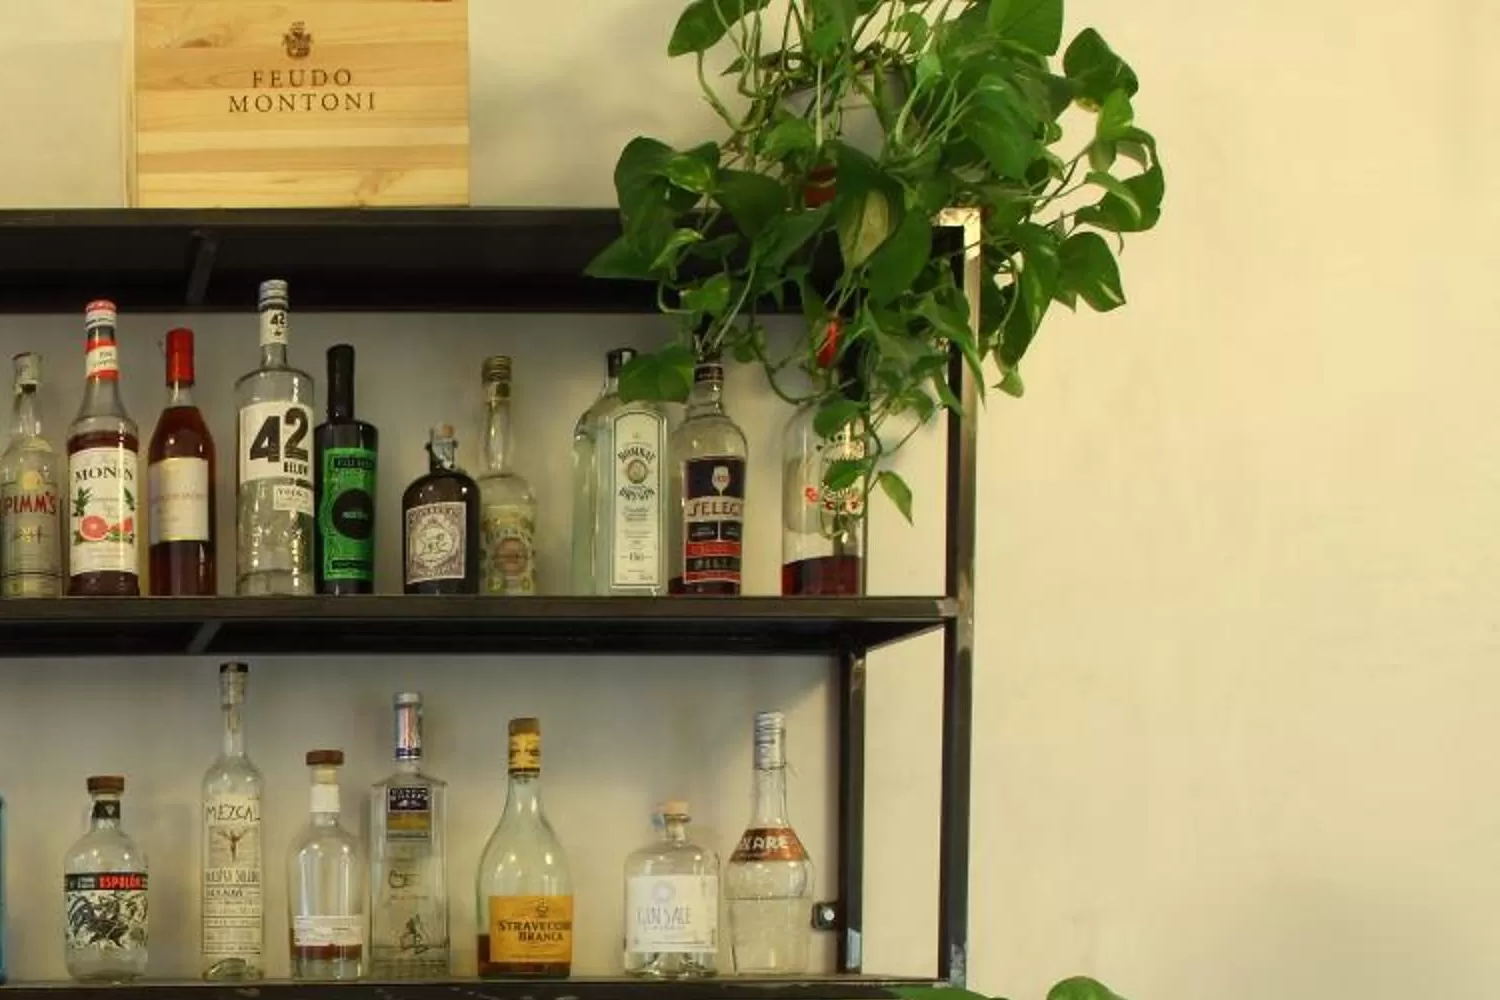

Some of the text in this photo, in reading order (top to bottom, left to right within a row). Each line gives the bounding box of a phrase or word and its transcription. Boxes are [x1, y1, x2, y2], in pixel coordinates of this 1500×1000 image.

[252, 68, 353, 89] FEUDO
[228, 92, 377, 114] MONTONI
[270, 313, 286, 327] 42
[249, 407, 309, 463] 42
[4, 491, 56, 515] PIMM'S
